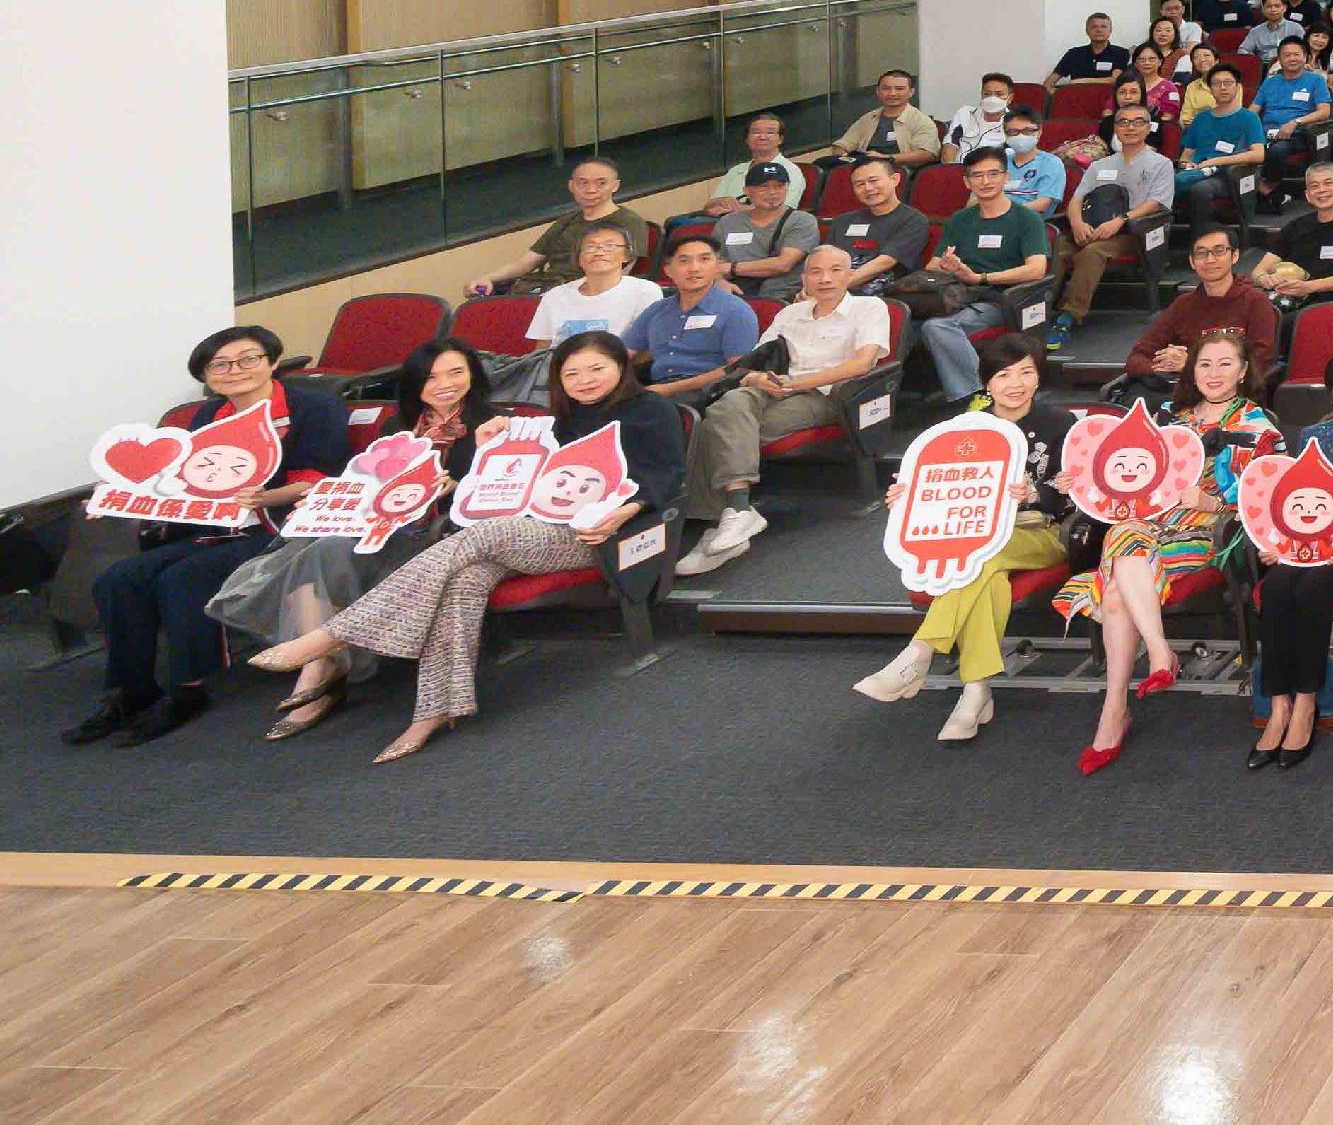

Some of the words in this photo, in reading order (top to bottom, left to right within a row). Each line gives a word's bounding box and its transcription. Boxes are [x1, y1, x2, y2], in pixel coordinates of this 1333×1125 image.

[925, 466, 994, 483] 捐血救人
[921, 486, 992, 501] BLOOD
[947, 505, 987, 519] FOR
[944, 520, 985, 535] LIFE
